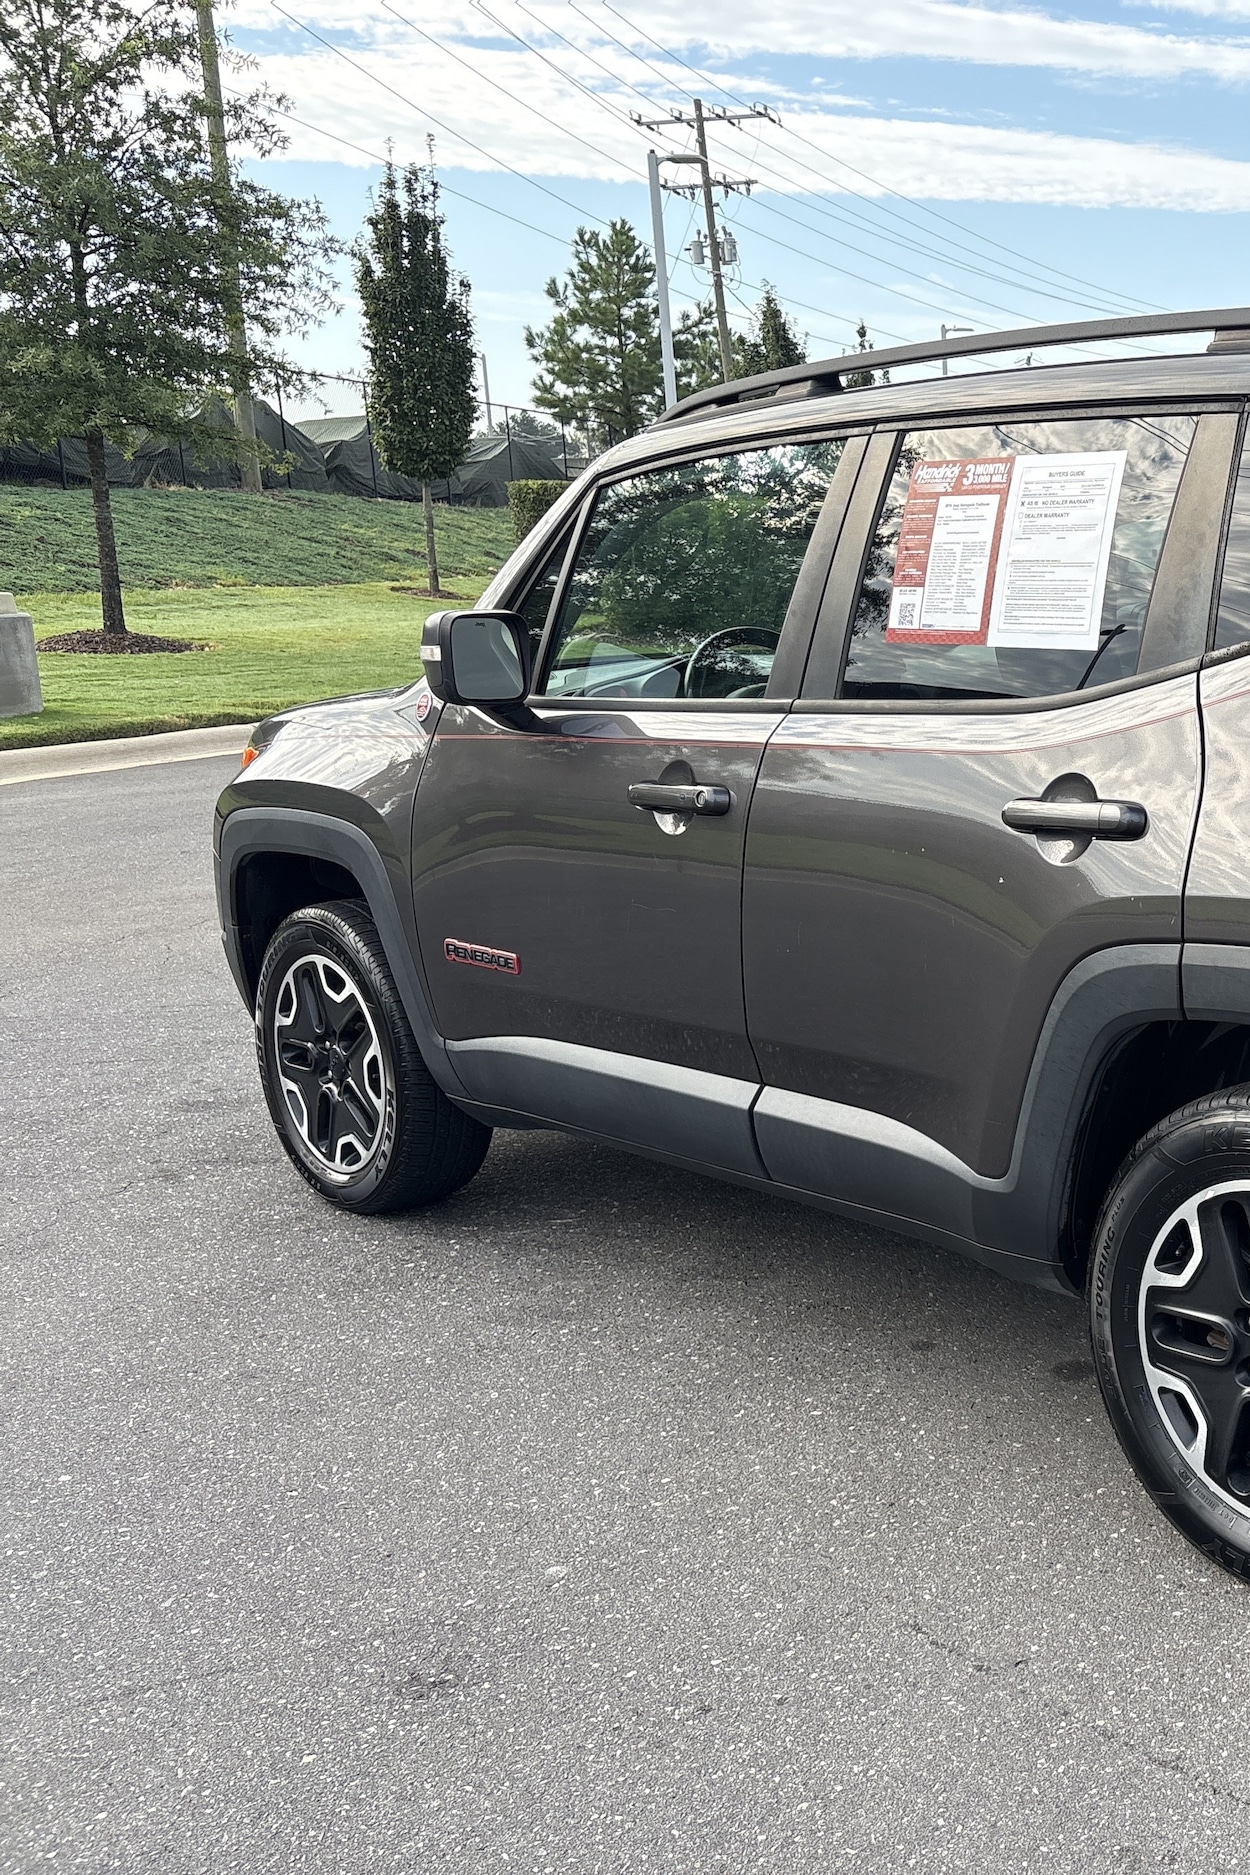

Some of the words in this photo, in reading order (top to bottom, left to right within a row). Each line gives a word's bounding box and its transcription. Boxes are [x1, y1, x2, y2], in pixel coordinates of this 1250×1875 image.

[915, 463, 962, 484] Hendrick
[963, 464, 976, 486] 3
[975, 463, 1011, 474] MONTH/
[973, 475, 990, 484] 3,000
[990, 474, 1009, 483] MILE
[445, 941, 517, 971] RENEGADE
[375, 1087, 395, 1181] KELLY
[1095, 1226, 1117, 1320] TOURING
[1111, 1195, 1126, 1224] PLUS
